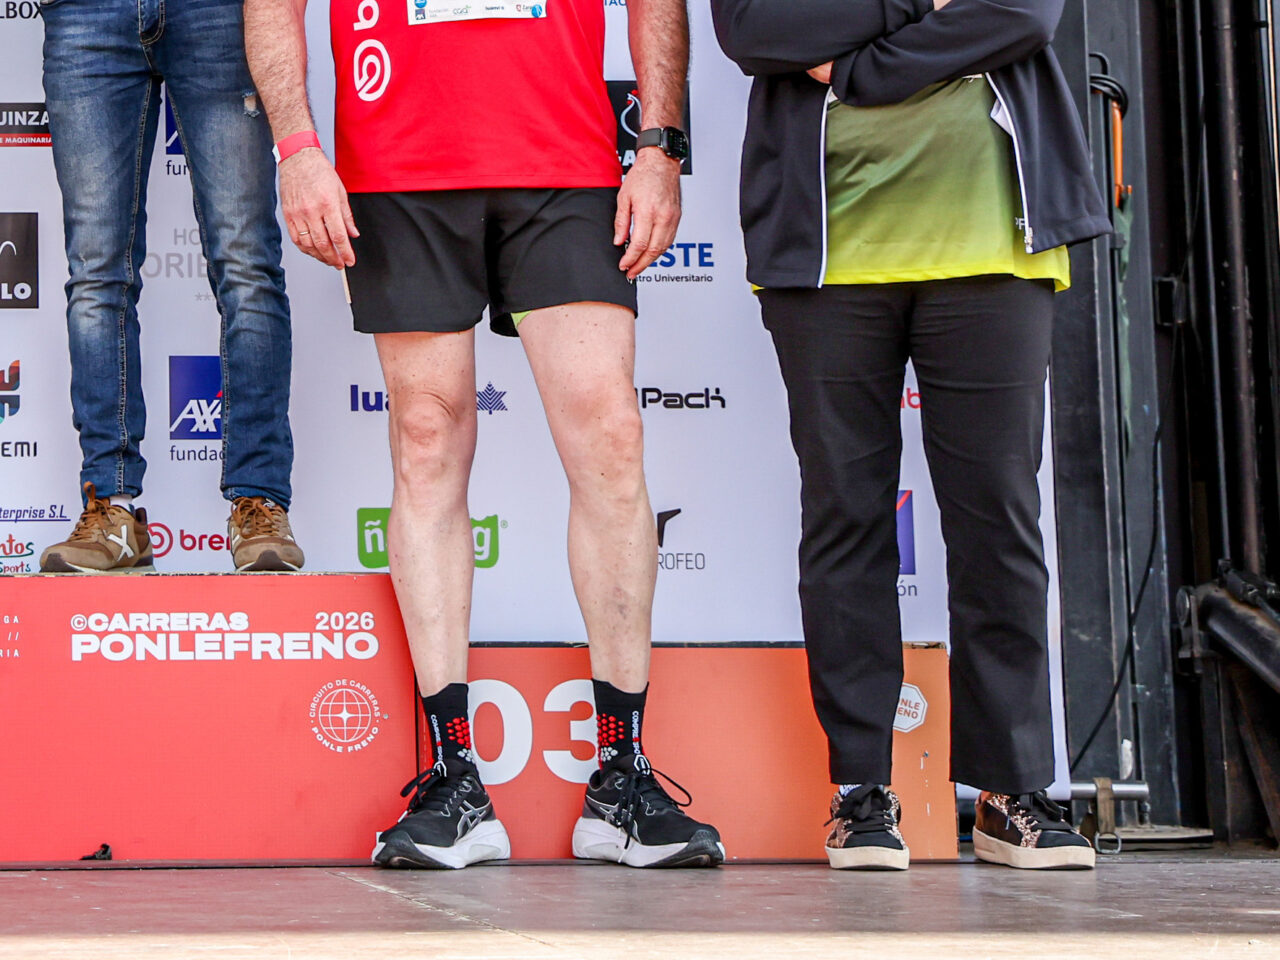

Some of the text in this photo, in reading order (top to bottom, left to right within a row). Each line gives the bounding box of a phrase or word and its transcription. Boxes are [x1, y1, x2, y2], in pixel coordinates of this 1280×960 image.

[142, 253, 207, 278] ORIE
[648, 243, 714, 267] STE
[654, 273, 713, 283] Universitario
[640, 387, 726, 409] Pack
[180, 530, 229, 551] bre
[657, 552, 706, 571] ROFEO
[315, 612, 375, 630] 2026
[70, 632, 380, 661] PONLEFRENO
[309, 681, 334, 718] CIRCUITO
[349, 680, 381, 717] CARRERAS
[900, 698, 921, 711] NLE
[897, 707, 918, 719] ENO
[311, 726, 380, 753] PONLE FRENO
[465, 677, 602, 788] 03
